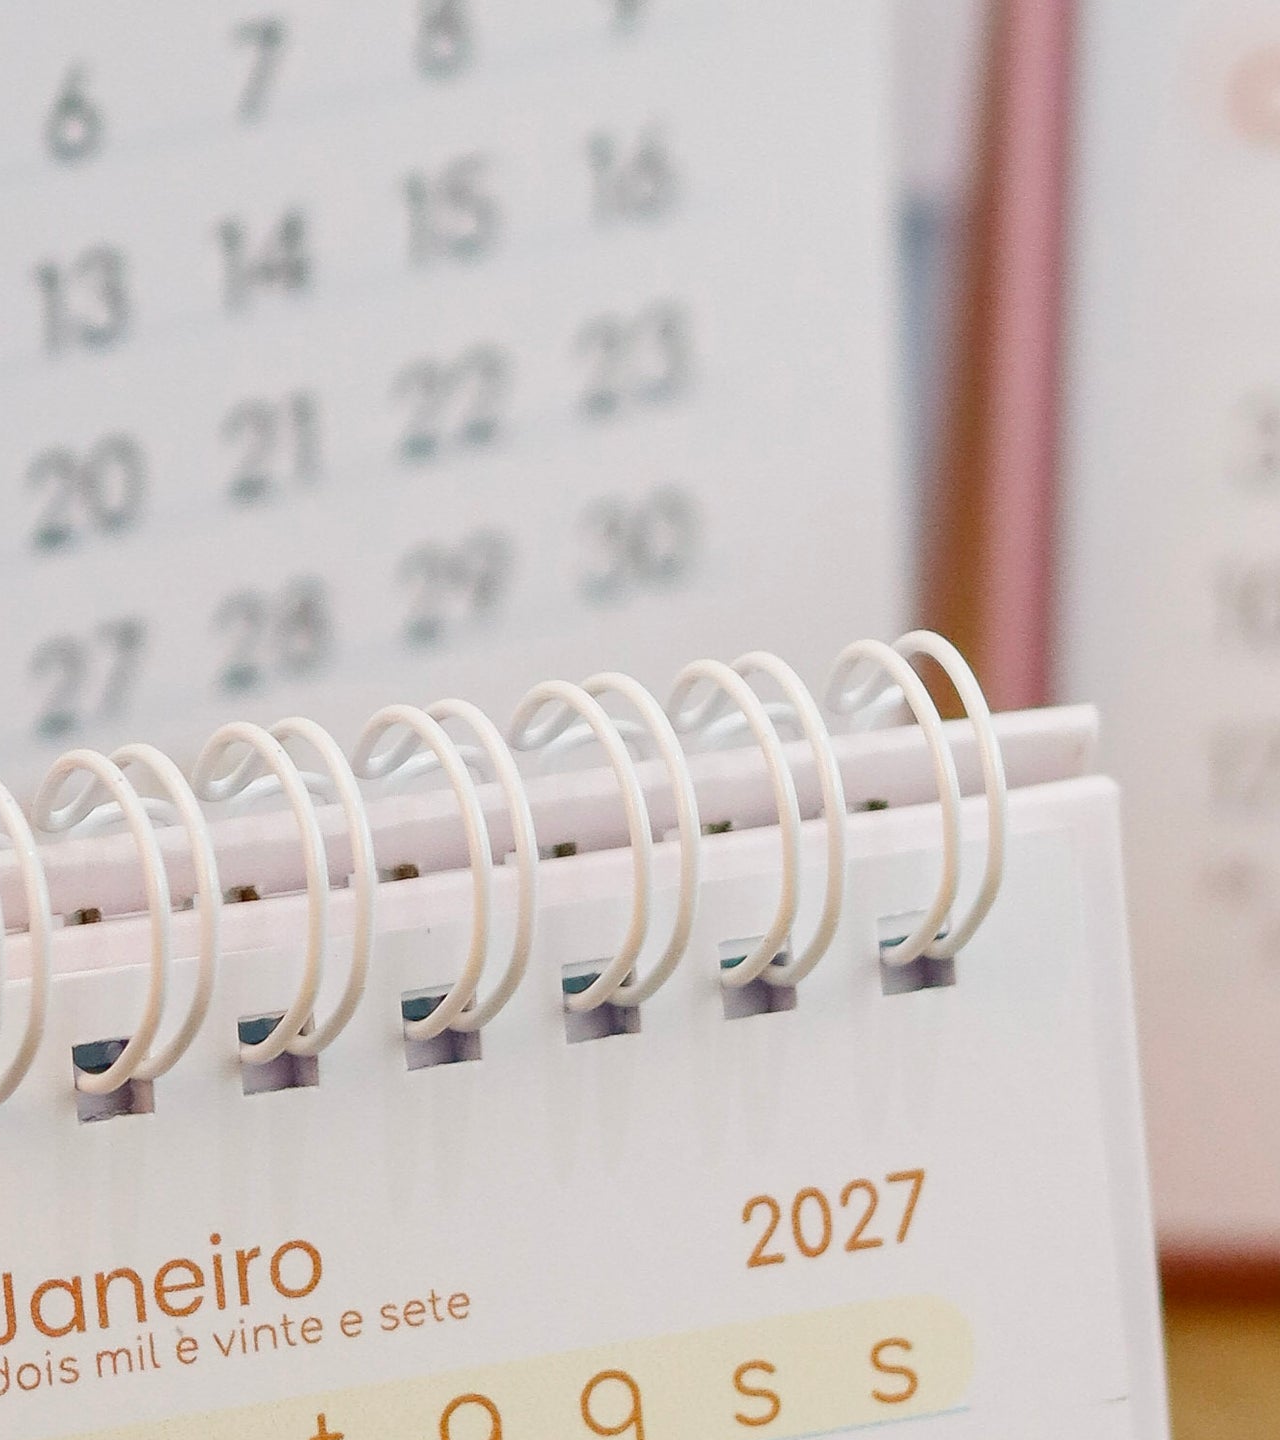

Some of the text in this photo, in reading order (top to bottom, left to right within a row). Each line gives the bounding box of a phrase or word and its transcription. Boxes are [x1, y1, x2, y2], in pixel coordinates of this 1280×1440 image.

[43, 67, 106, 165] 6
[231, 16, 289, 120] 7
[33, 247, 133, 355] 13
[218, 208, 316, 308] 14
[402, 158, 500, 266] 15
[586, 129, 680, 226] 16
[27, 436, 146, 555] 20
[223, 392, 323, 508] 21
[396, 349, 508, 462] 22
[576, 303, 692, 421] 23
[32, 621, 147, 743] 27
[219, 580, 332, 695] 28
[399, 533, 514, 652] 29
[578, 490, 696, 604] 30
[742, 1169, 925, 1268] 2027
[96, 1333, 160, 1377] mil
[176, 1337, 198, 1365] e
[213, 1314, 323, 1357] vinte
[340, 1310, 363, 1338] e
[380, 1290, 470, 1331] sete
[733, 1361, 781, 1427] s
[871, 1338, 918, 1404] s
